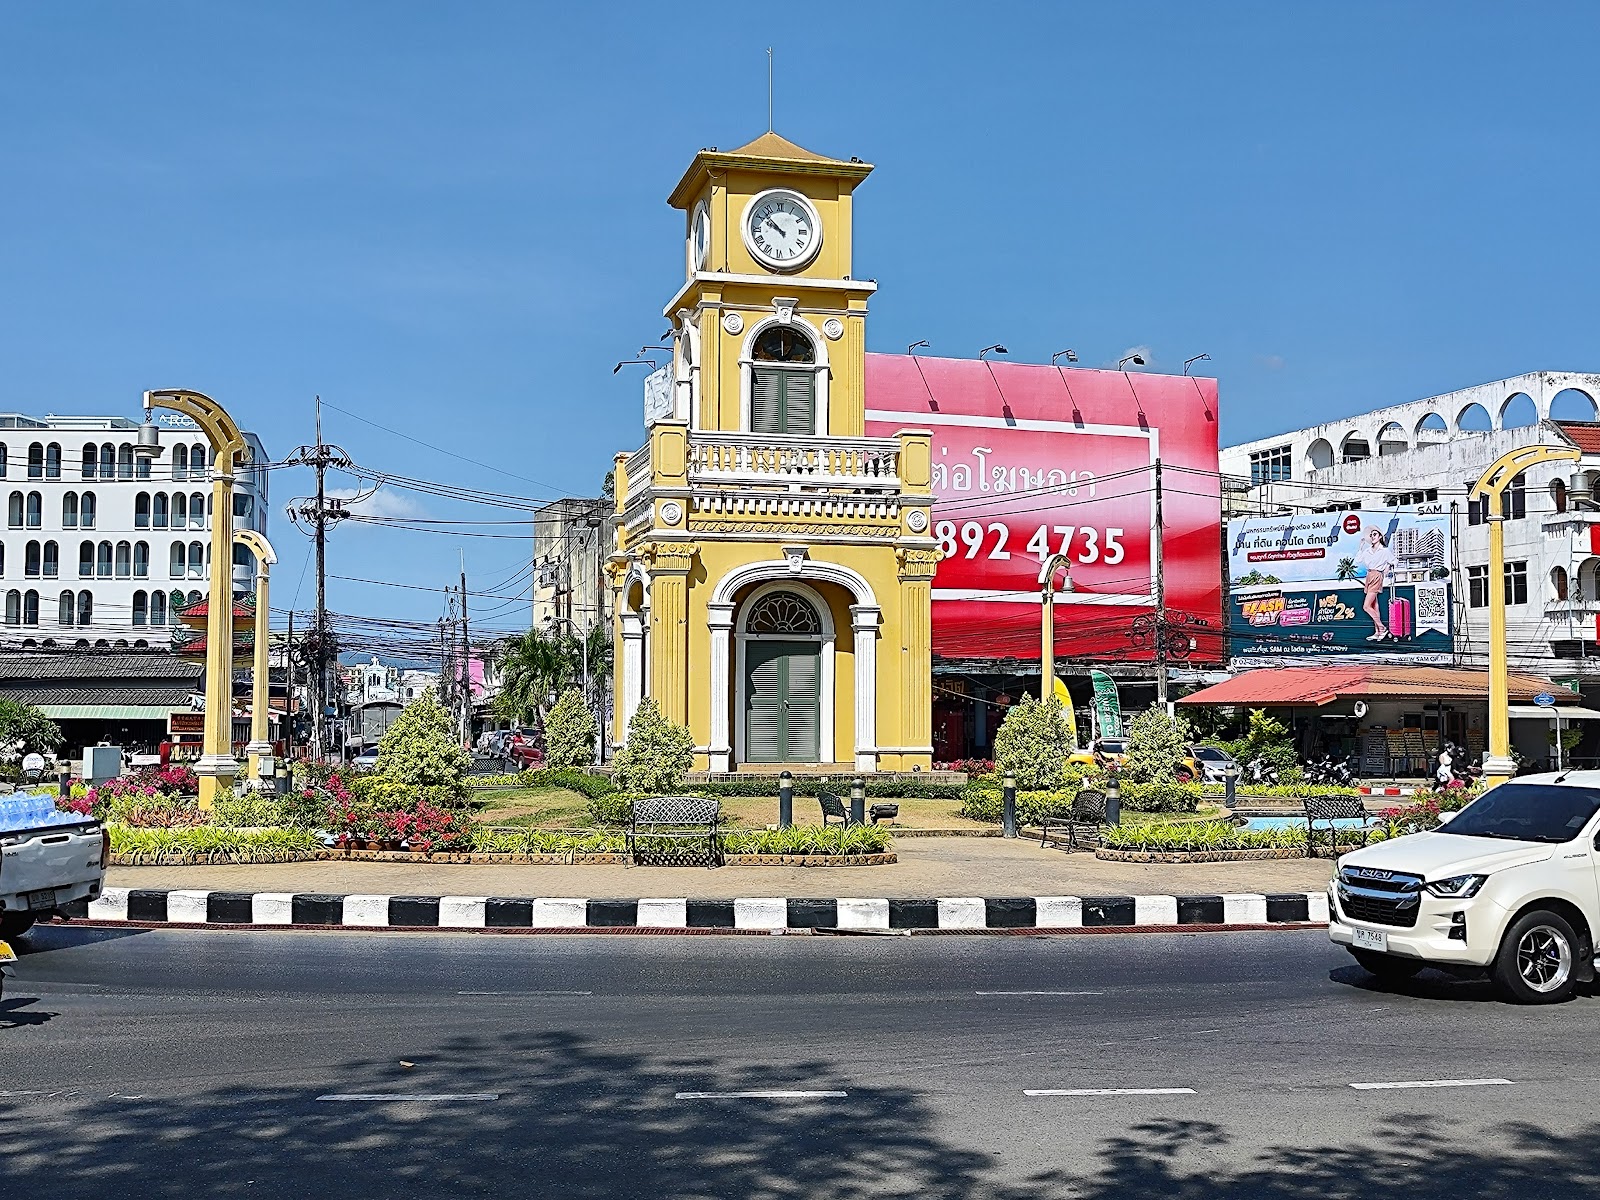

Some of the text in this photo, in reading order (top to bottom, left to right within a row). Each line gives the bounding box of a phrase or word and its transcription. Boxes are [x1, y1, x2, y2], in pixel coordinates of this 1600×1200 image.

[1418, 504, 1442, 515] SAM
[1312, 522, 1326, 530] SAM
[1026, 523, 1125, 565] 4735
[1253, 535, 1272, 548] ที่ดิน
[1243, 599, 1284, 614] FLASH
[1334, 602, 1355, 620] 2%
[1255, 610, 1277, 623] DAY
[1269, 645, 1282, 653] SAM
[1360, 868, 1392, 880] ISUZU
